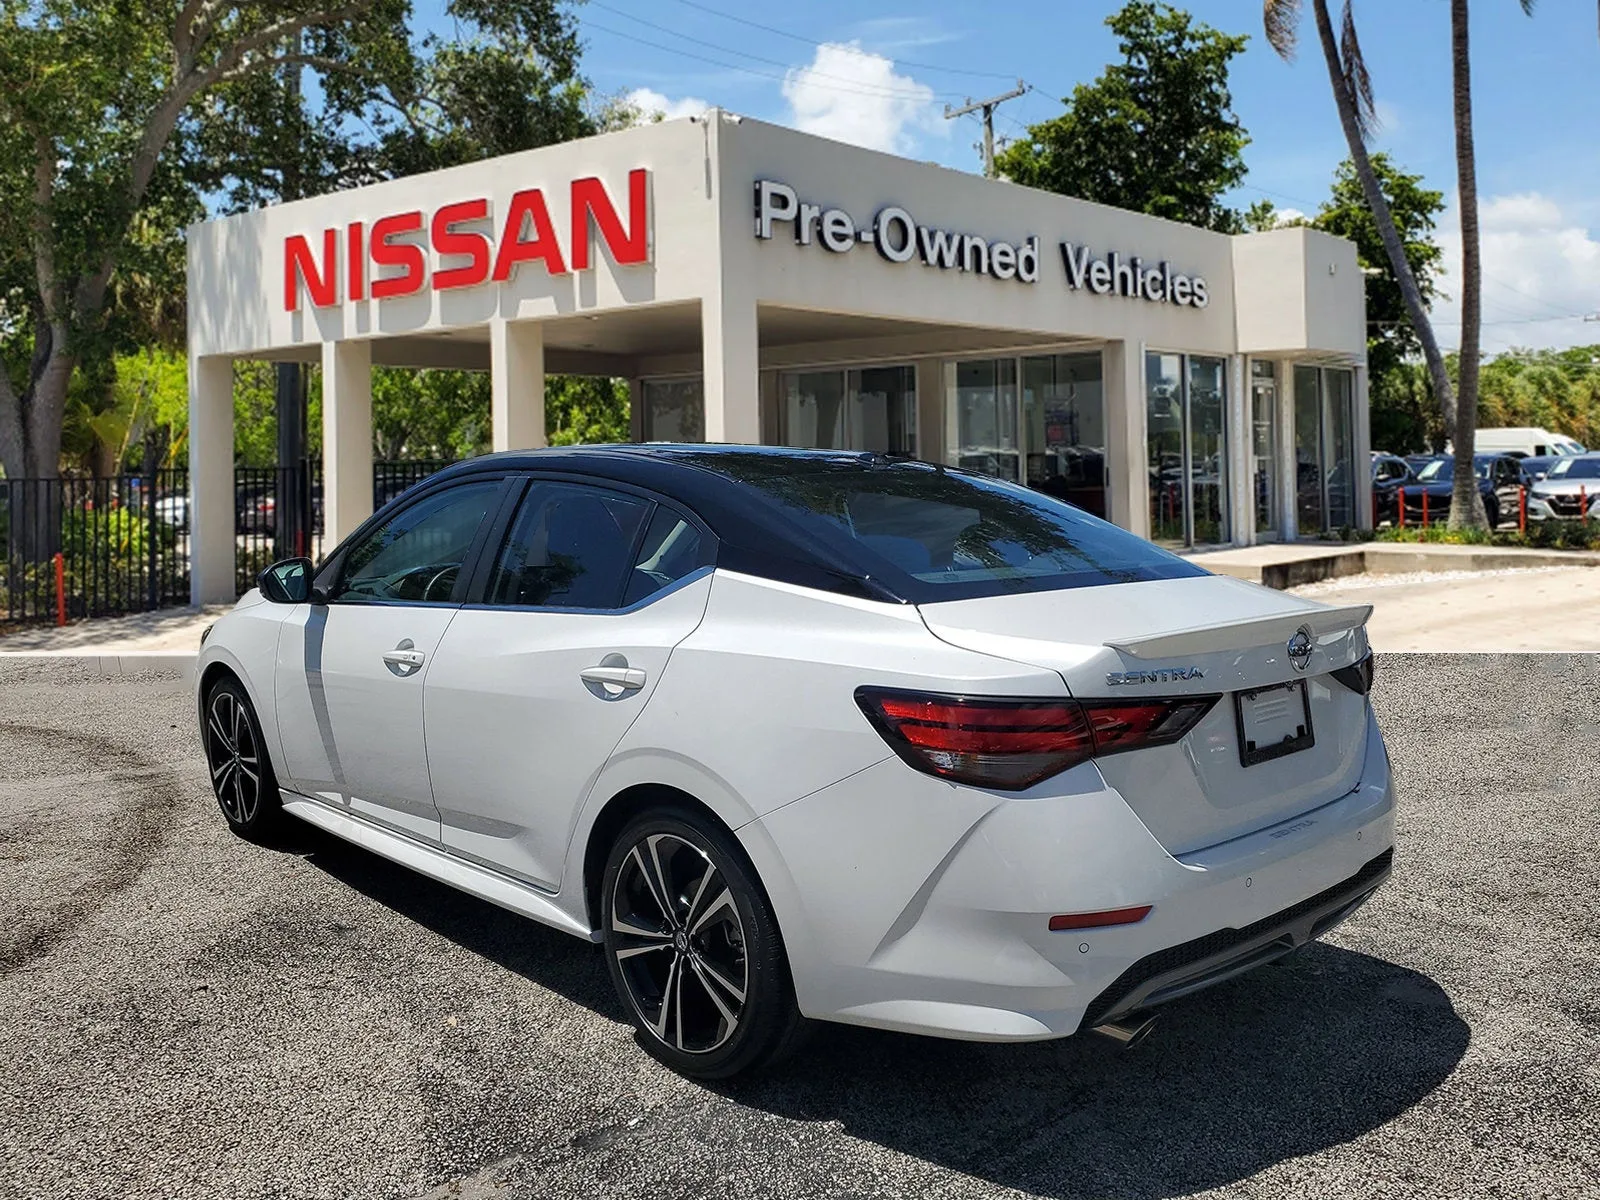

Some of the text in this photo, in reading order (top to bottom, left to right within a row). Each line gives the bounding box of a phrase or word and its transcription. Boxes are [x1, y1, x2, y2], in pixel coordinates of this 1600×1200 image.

[284, 168, 648, 312] NISSAN
[755, 179, 1208, 308] Pre-Owned Vehicles
[1105, 666, 1204, 686] SENTRA
